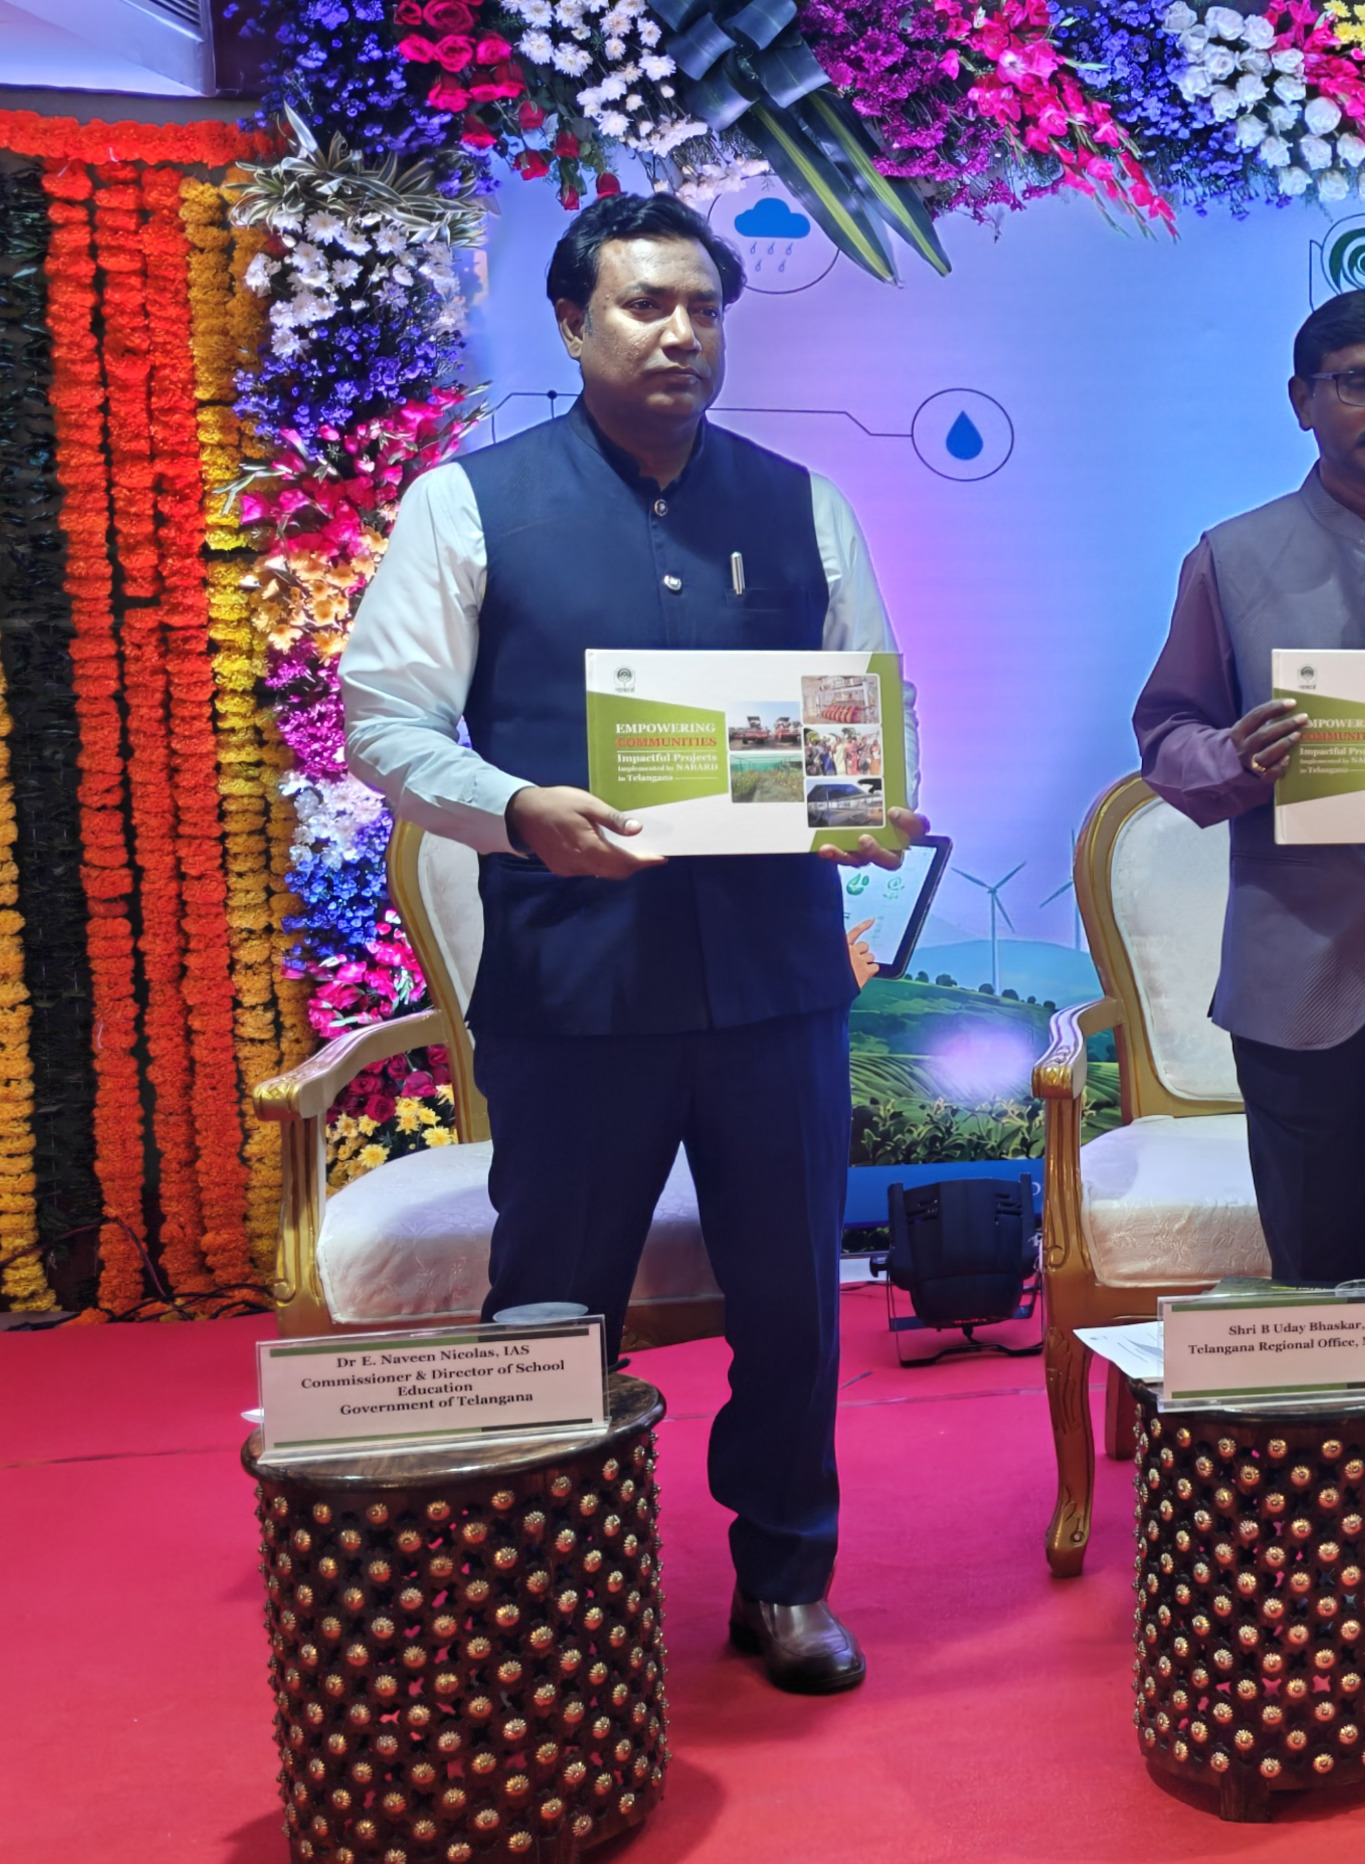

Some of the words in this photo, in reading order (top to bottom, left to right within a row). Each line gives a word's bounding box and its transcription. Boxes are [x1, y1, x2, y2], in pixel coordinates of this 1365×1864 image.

[616, 723, 715, 733] EMPOWERING
[616, 738, 717, 747] COMMUNITIES
[618, 753, 670, 763] Impactful
[673, 753, 717, 762] Projects
[1228, 1325, 1256, 1336] Shri
[1261, 1325, 1270, 1334] B
[1274, 1323, 1305, 1335] Uday
[1309, 1320, 1365, 1332] Bhaskar,
[1188, 1342, 1255, 1356] Telangana
[1259, 1339, 1314, 1352] Regional
[1317, 1337, 1359, 1348] Office,
[336, 1357, 356, 1369] Dr
[362, 1355, 377, 1367] E.
[381, 1352, 435, 1365] Naveen
[440, 1348, 499, 1361] Nicolas,
[504, 1345, 530, 1356] IAS
[301, 1371, 412, 1389] Commissioner
[415, 1370, 426, 1381] &
[432, 1364, 493, 1380] Director
[497, 1363, 514, 1374] of
[516, 1360, 565, 1373] School
[398, 1382, 473, 1397] Education
[340, 1399, 434, 1415] Government
[438, 1396, 454, 1408] of
[456, 1392, 533, 1406] Telangana
